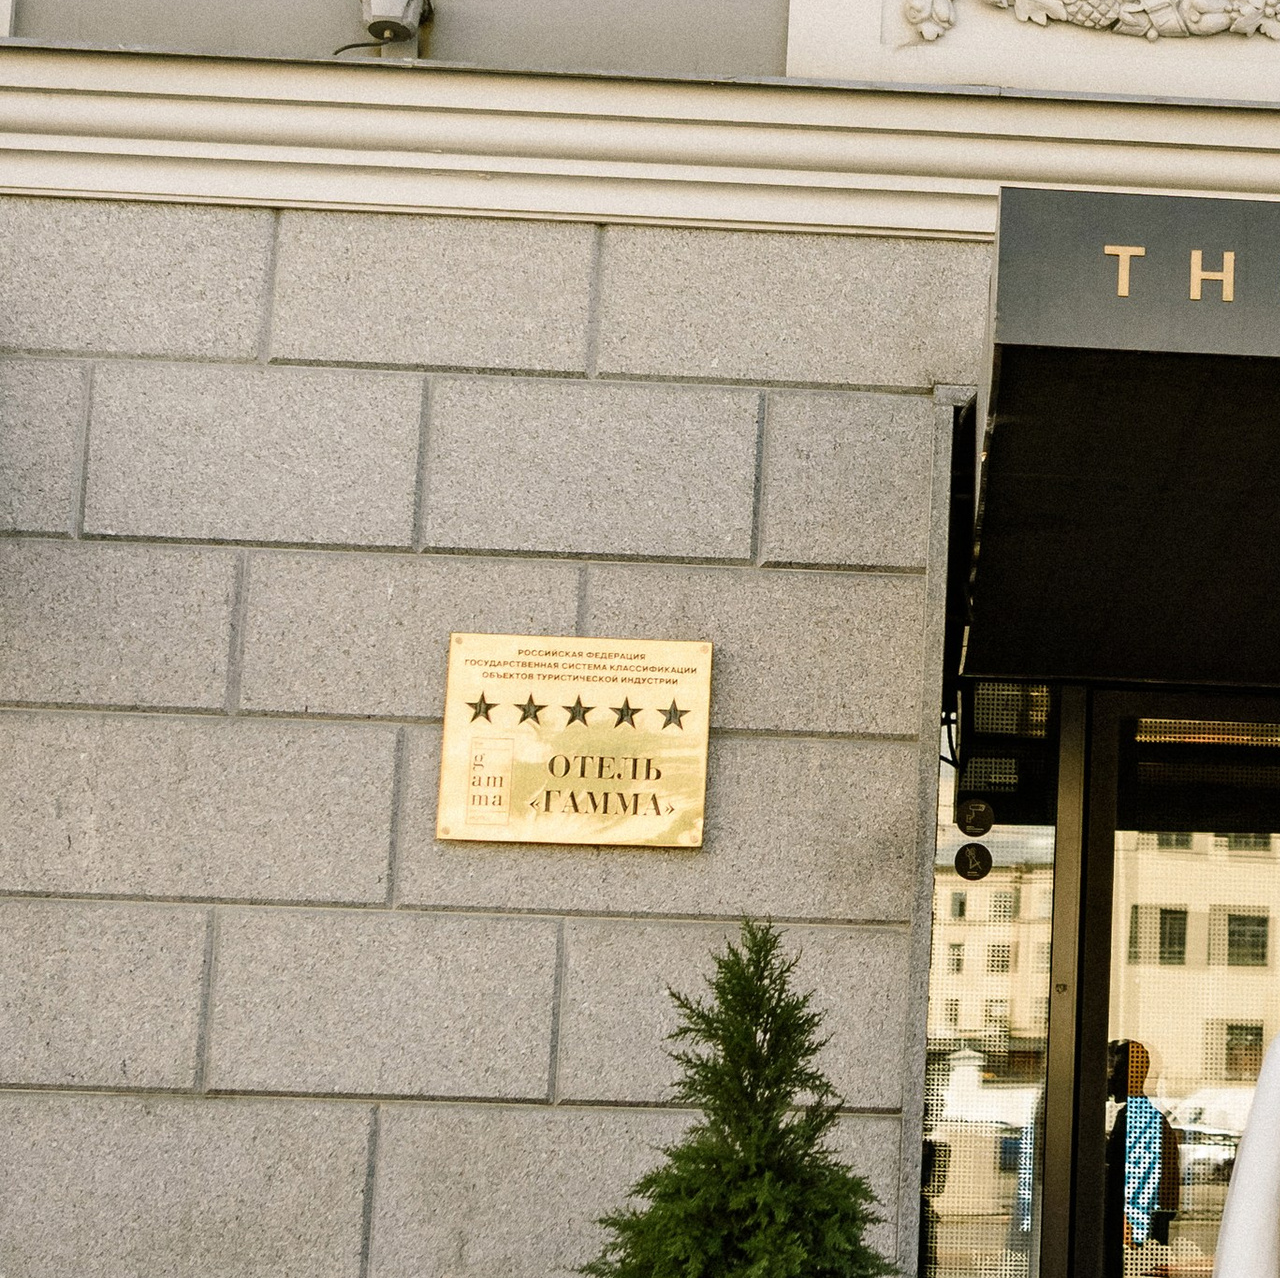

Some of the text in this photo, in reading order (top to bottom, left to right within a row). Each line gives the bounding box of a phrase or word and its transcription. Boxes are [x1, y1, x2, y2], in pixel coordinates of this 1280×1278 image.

[517, 648, 646, 661] РОССИЙСКАЯ ФЕДЕРАЦИЯ
[464, 658, 697, 675] ГОСУДАРСТВЕННАЯ СИСТЕМА КЛАССИФИКАЦИИ
[481, 671, 679, 685] ОБЪЕКТОВ ТУРИСТИЧЕСКОЙ ИНДУСТРИИ
[547, 753, 663, 782] ОТЕЛЬ
[529, 789, 676, 817] «ГАММА»
